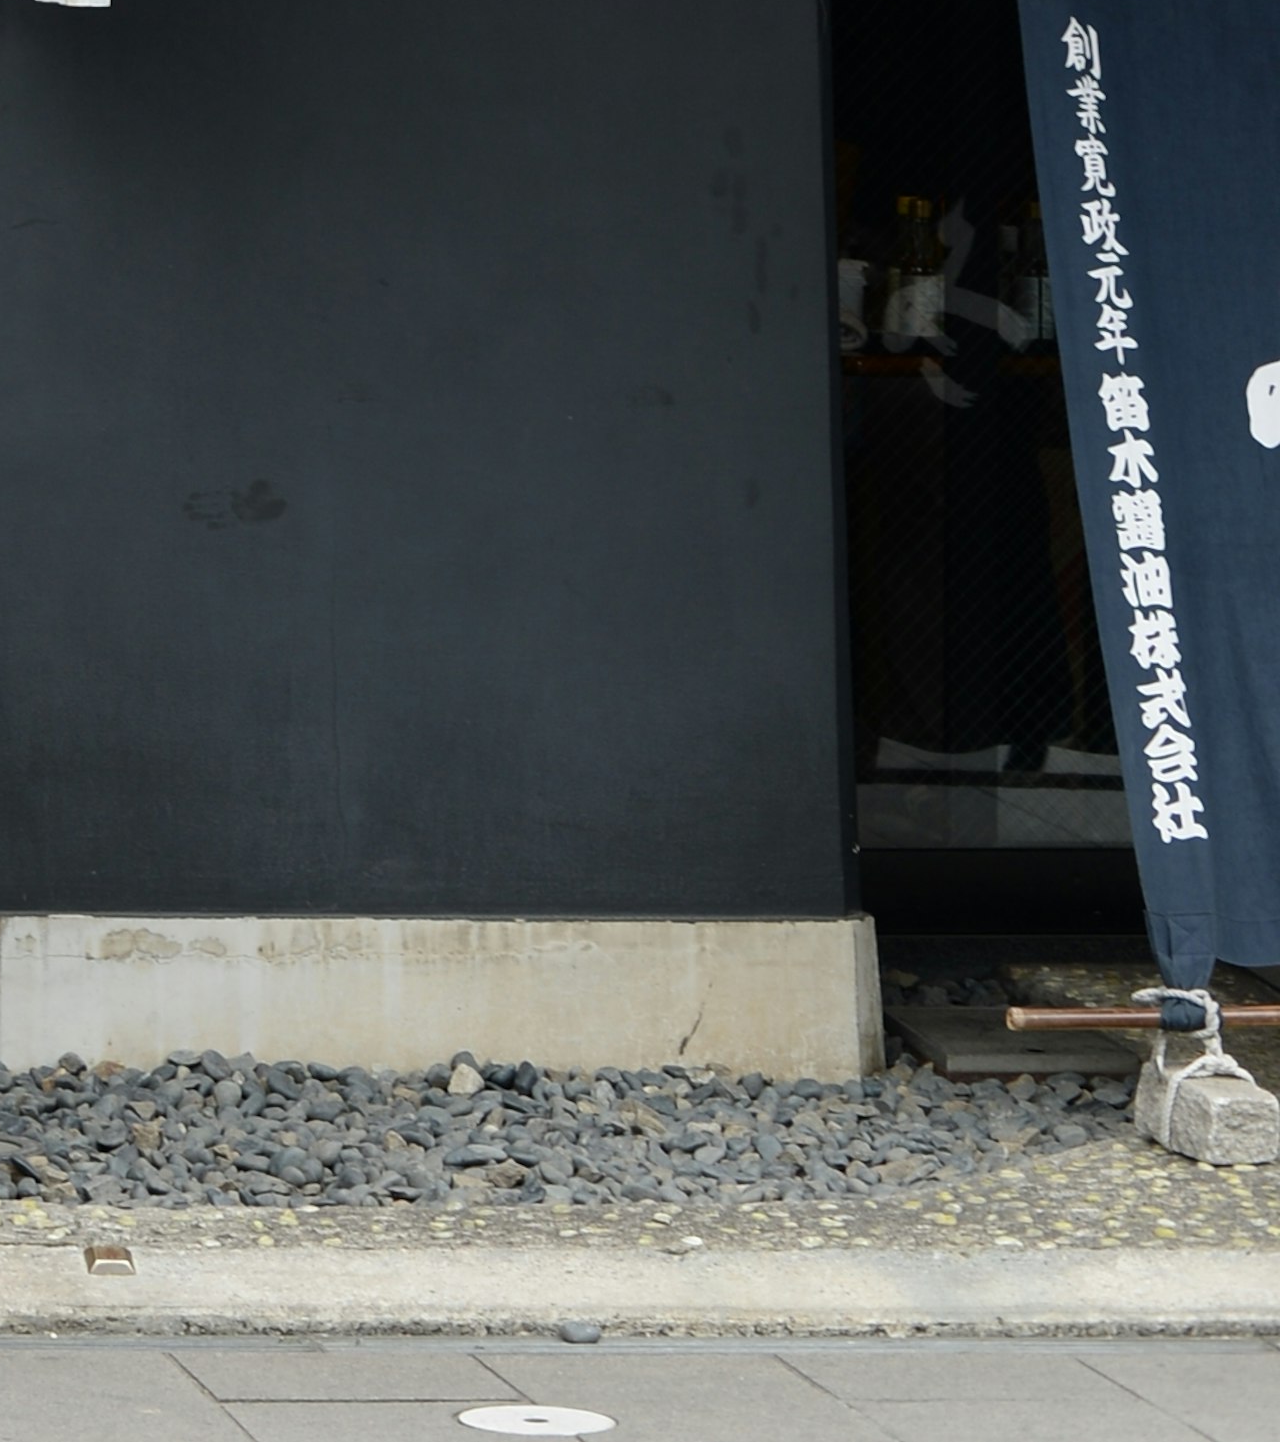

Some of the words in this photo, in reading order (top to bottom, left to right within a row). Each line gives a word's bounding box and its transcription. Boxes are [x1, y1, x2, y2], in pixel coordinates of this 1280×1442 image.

[1061, 16, 1139, 365] 創業寛政元年
